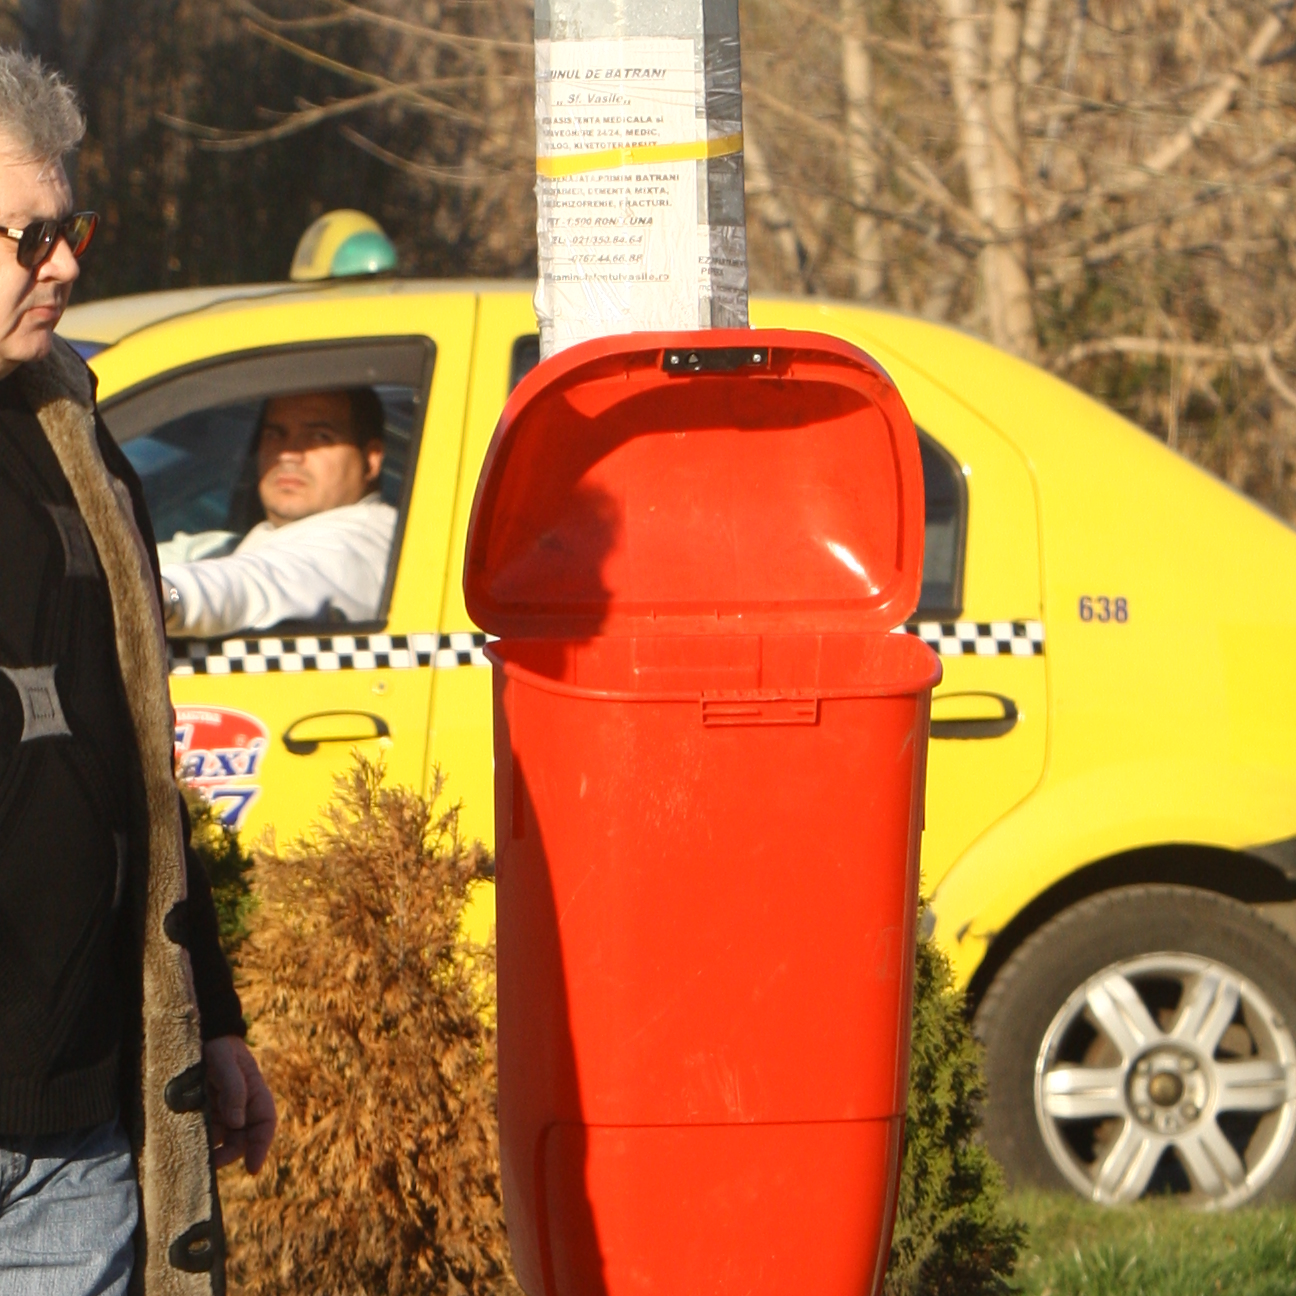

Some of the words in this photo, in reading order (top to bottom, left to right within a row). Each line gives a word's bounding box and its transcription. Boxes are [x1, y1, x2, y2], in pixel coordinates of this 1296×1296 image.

[585, 69, 603, 79] DE
[604, 68, 667, 79] BATRANI
[1079, 595, 1129, 623] 638
